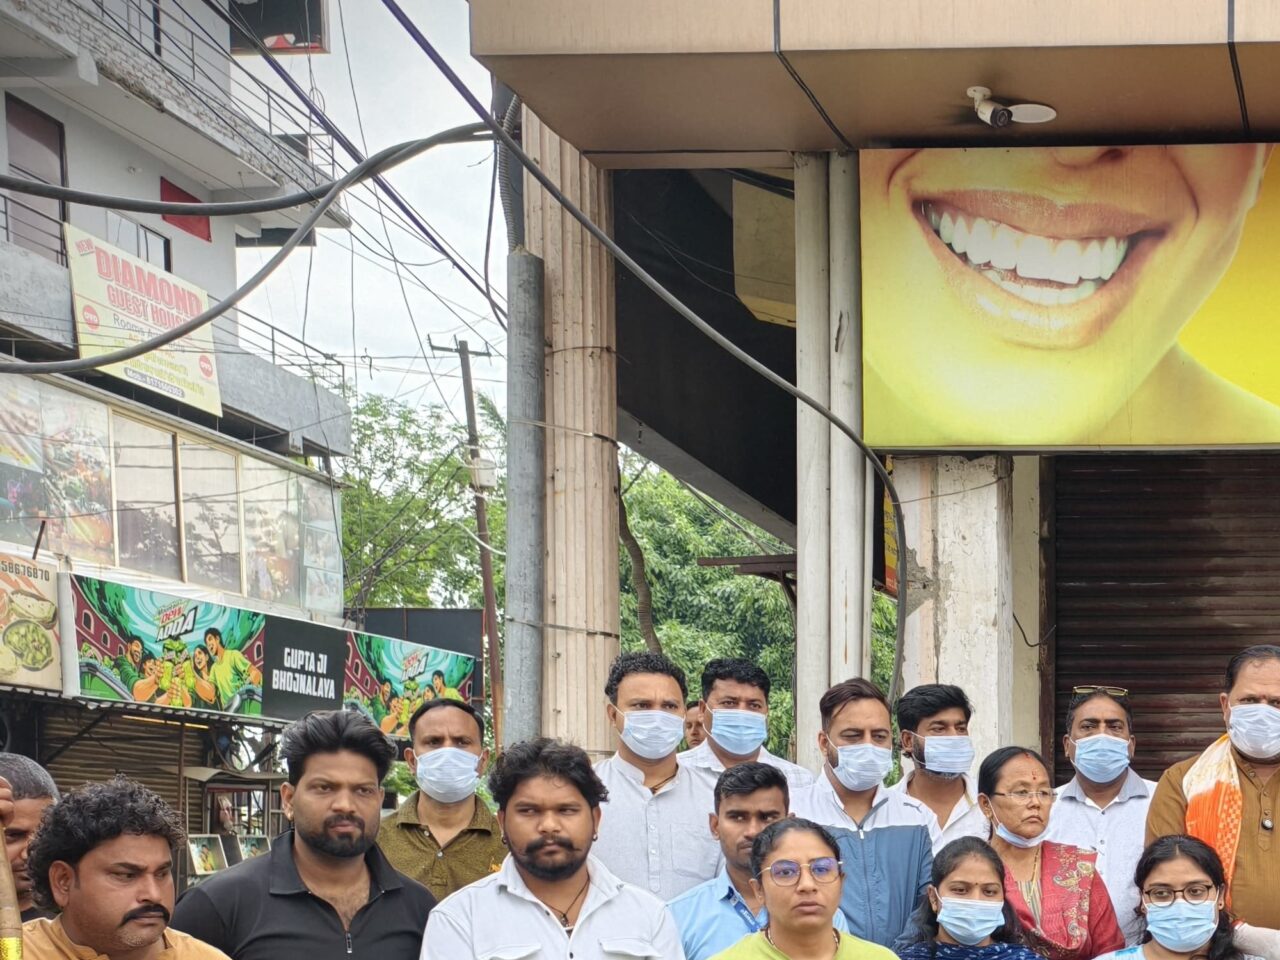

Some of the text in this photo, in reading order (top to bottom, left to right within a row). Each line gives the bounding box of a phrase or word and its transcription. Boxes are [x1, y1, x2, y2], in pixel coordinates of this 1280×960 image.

[95, 247, 204, 317] DIAMOND
[284, 647, 328, 675] GUPTA JI
[272, 669, 335, 700] BHOJNALAYA
